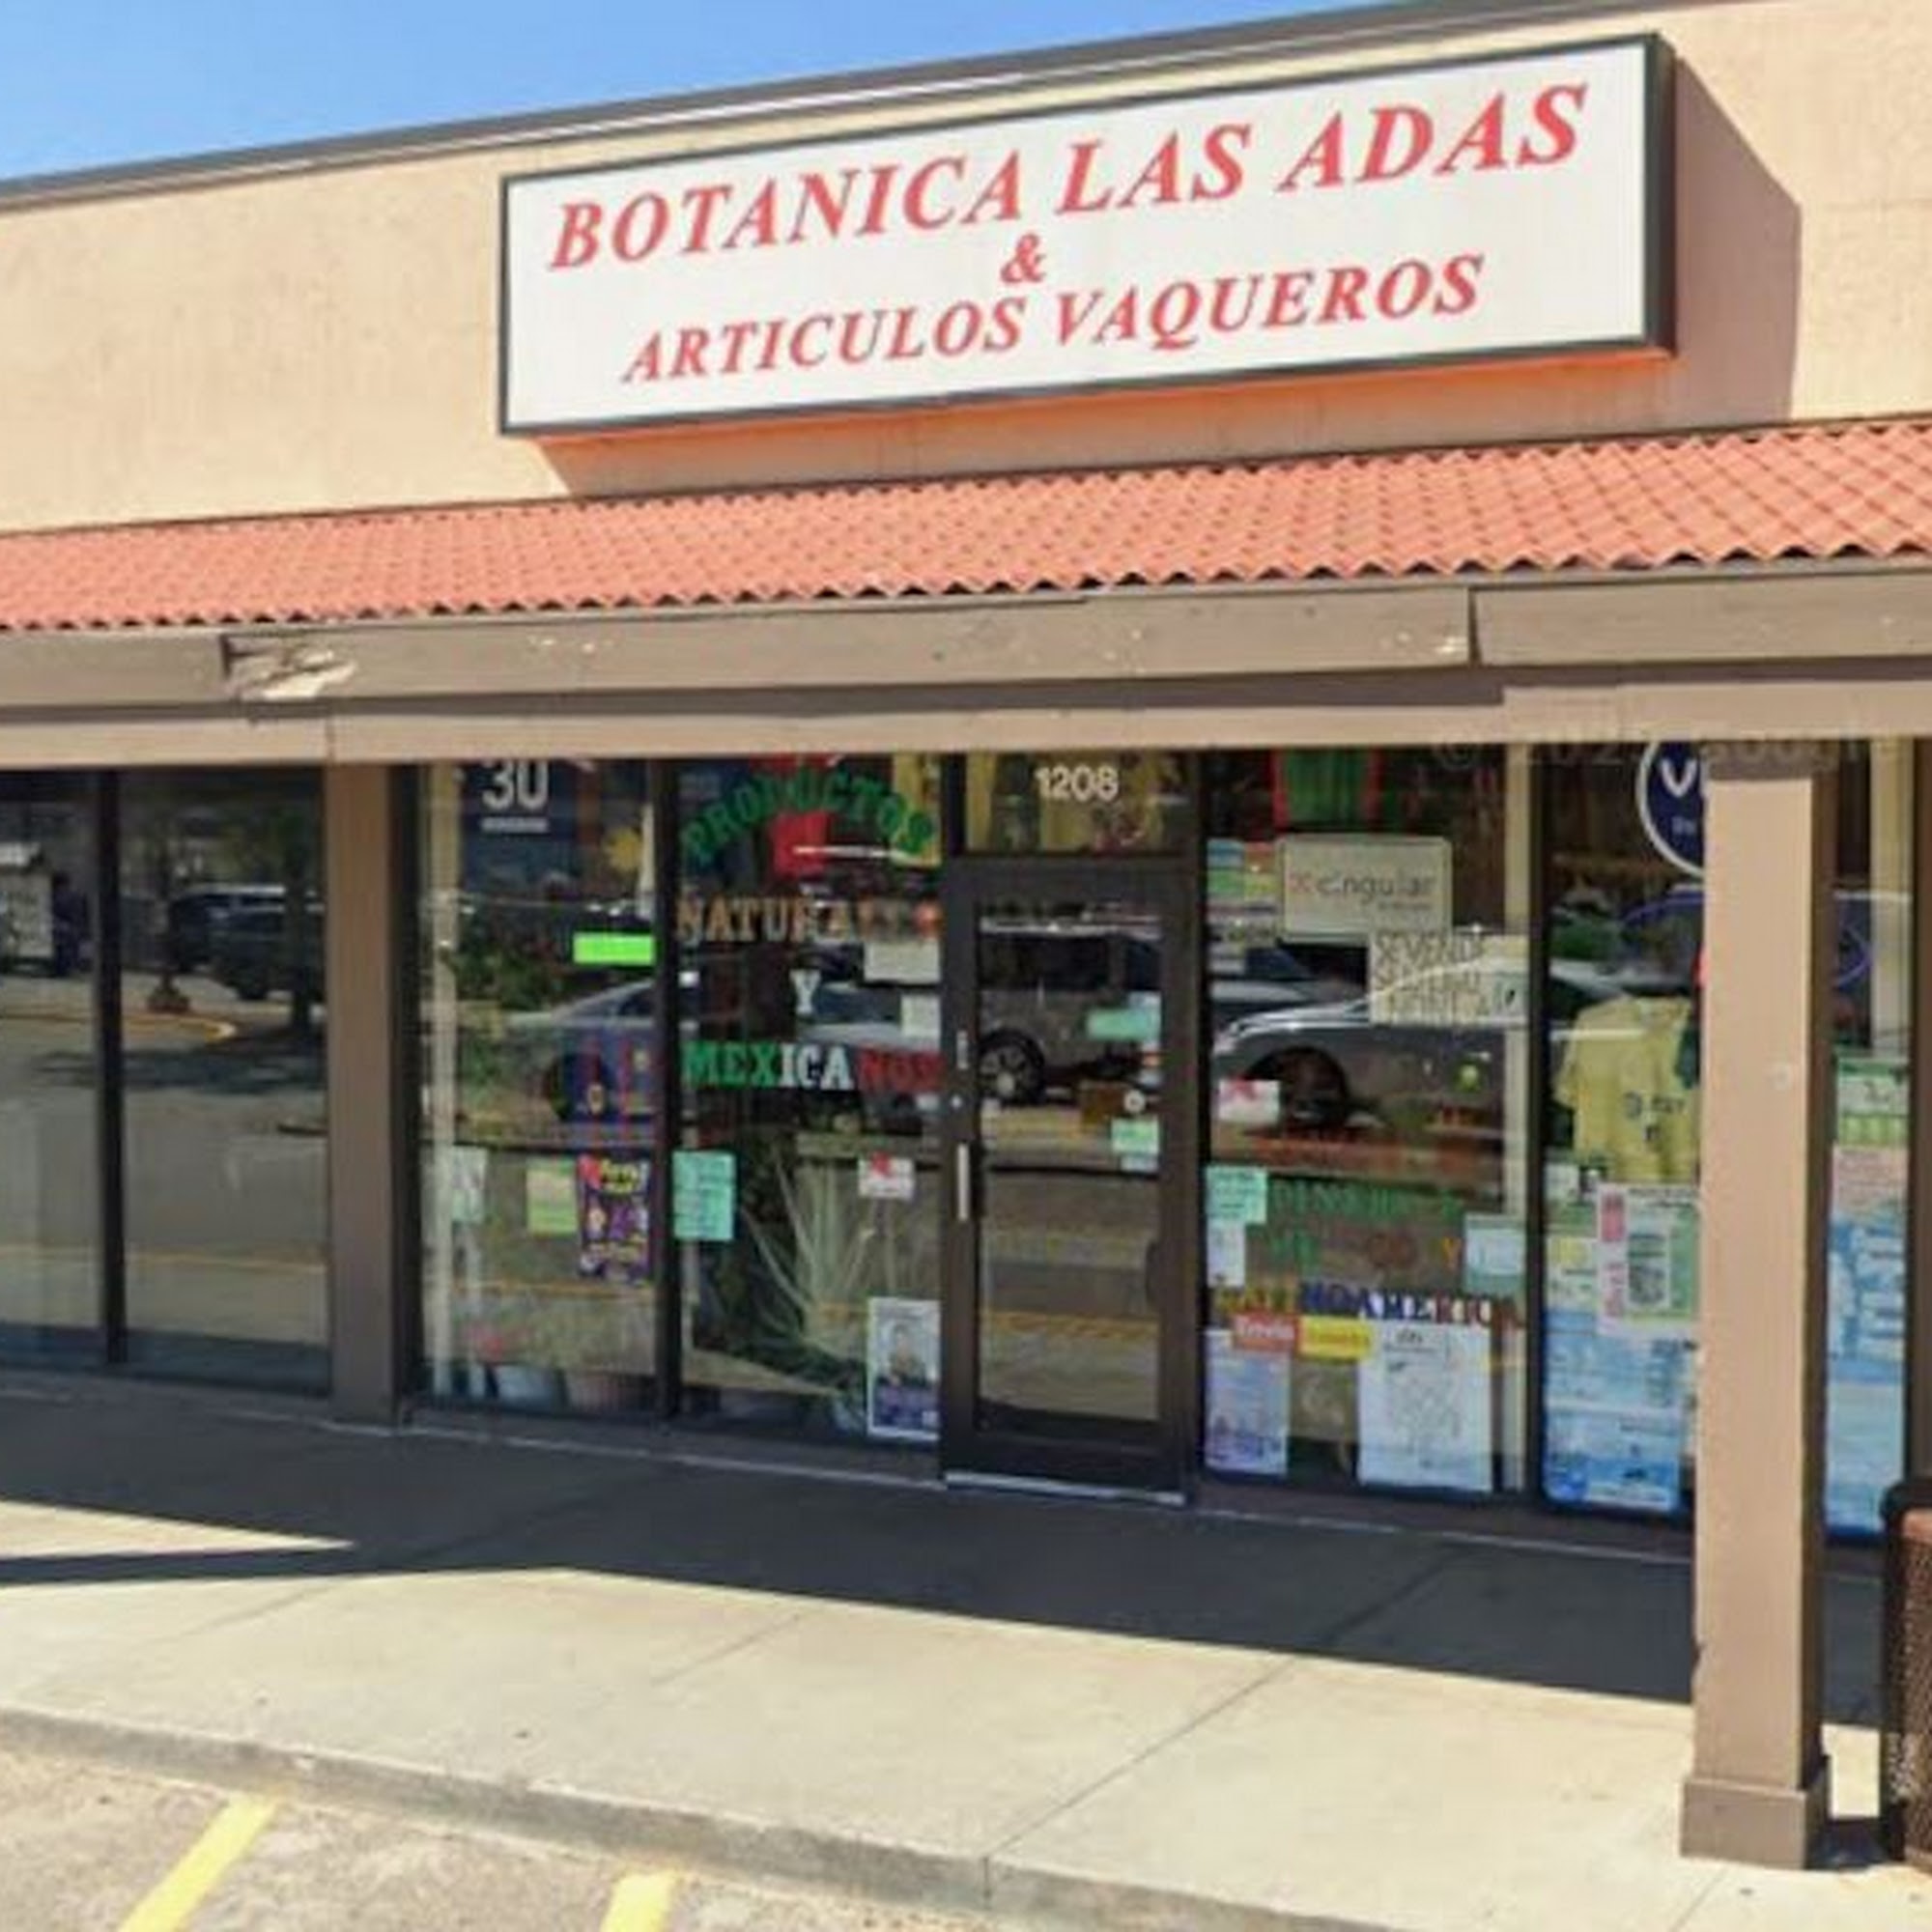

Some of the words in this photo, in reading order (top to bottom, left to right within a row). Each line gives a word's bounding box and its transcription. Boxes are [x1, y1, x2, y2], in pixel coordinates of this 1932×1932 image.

[549, 150, 1024, 272] BOTANICA
[1056, 120, 1256, 218] LAS
[1277, 78, 1588, 197] ADAS
[998, 228, 1044, 289] &
[623, 296, 1028, 383] ARTICULOS
[1056, 248, 1487, 356] VAQUEROS
[481, 760, 548, 807] 30
[1037, 766, 1118, 802] 1208
[682, 771, 934, 864] PRODUCTOS
[788, 969, 821, 1015] Y
